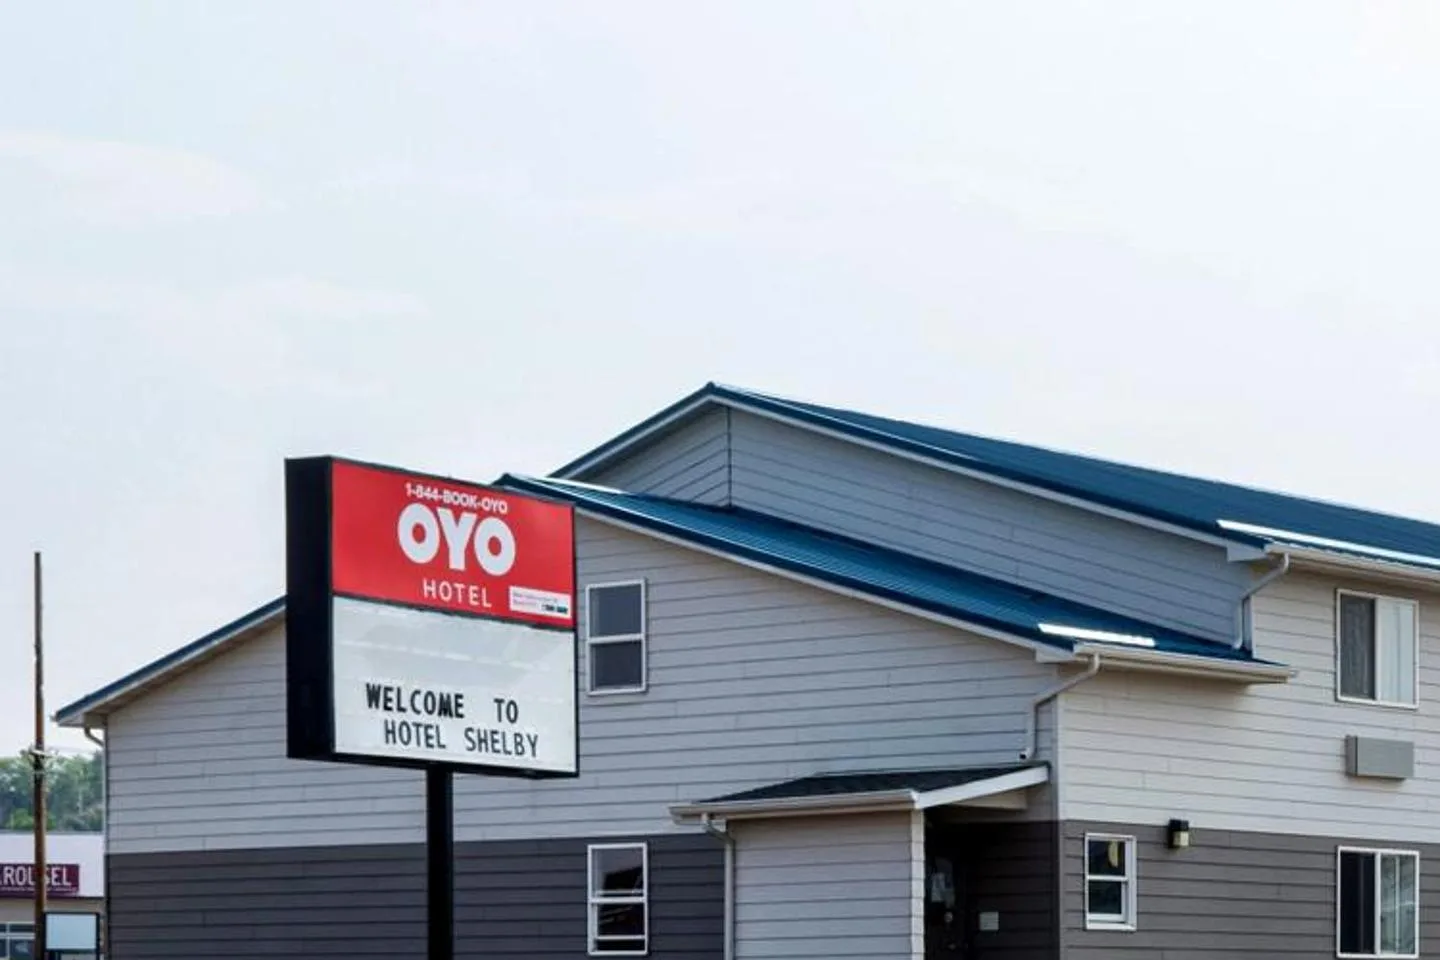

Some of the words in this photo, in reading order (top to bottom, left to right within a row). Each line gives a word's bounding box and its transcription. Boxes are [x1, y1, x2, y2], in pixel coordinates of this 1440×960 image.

[405, 482, 508, 515] 1-844-BOOK-OYO
[397, 502, 516, 576] OYO
[423, 578, 492, 608] HOTEL
[366, 682, 465, 719] WELCOME
[493, 697, 519, 724] TO
[384, 719, 447, 749] HOTEL
[464, 726, 539, 758] SHELBY
